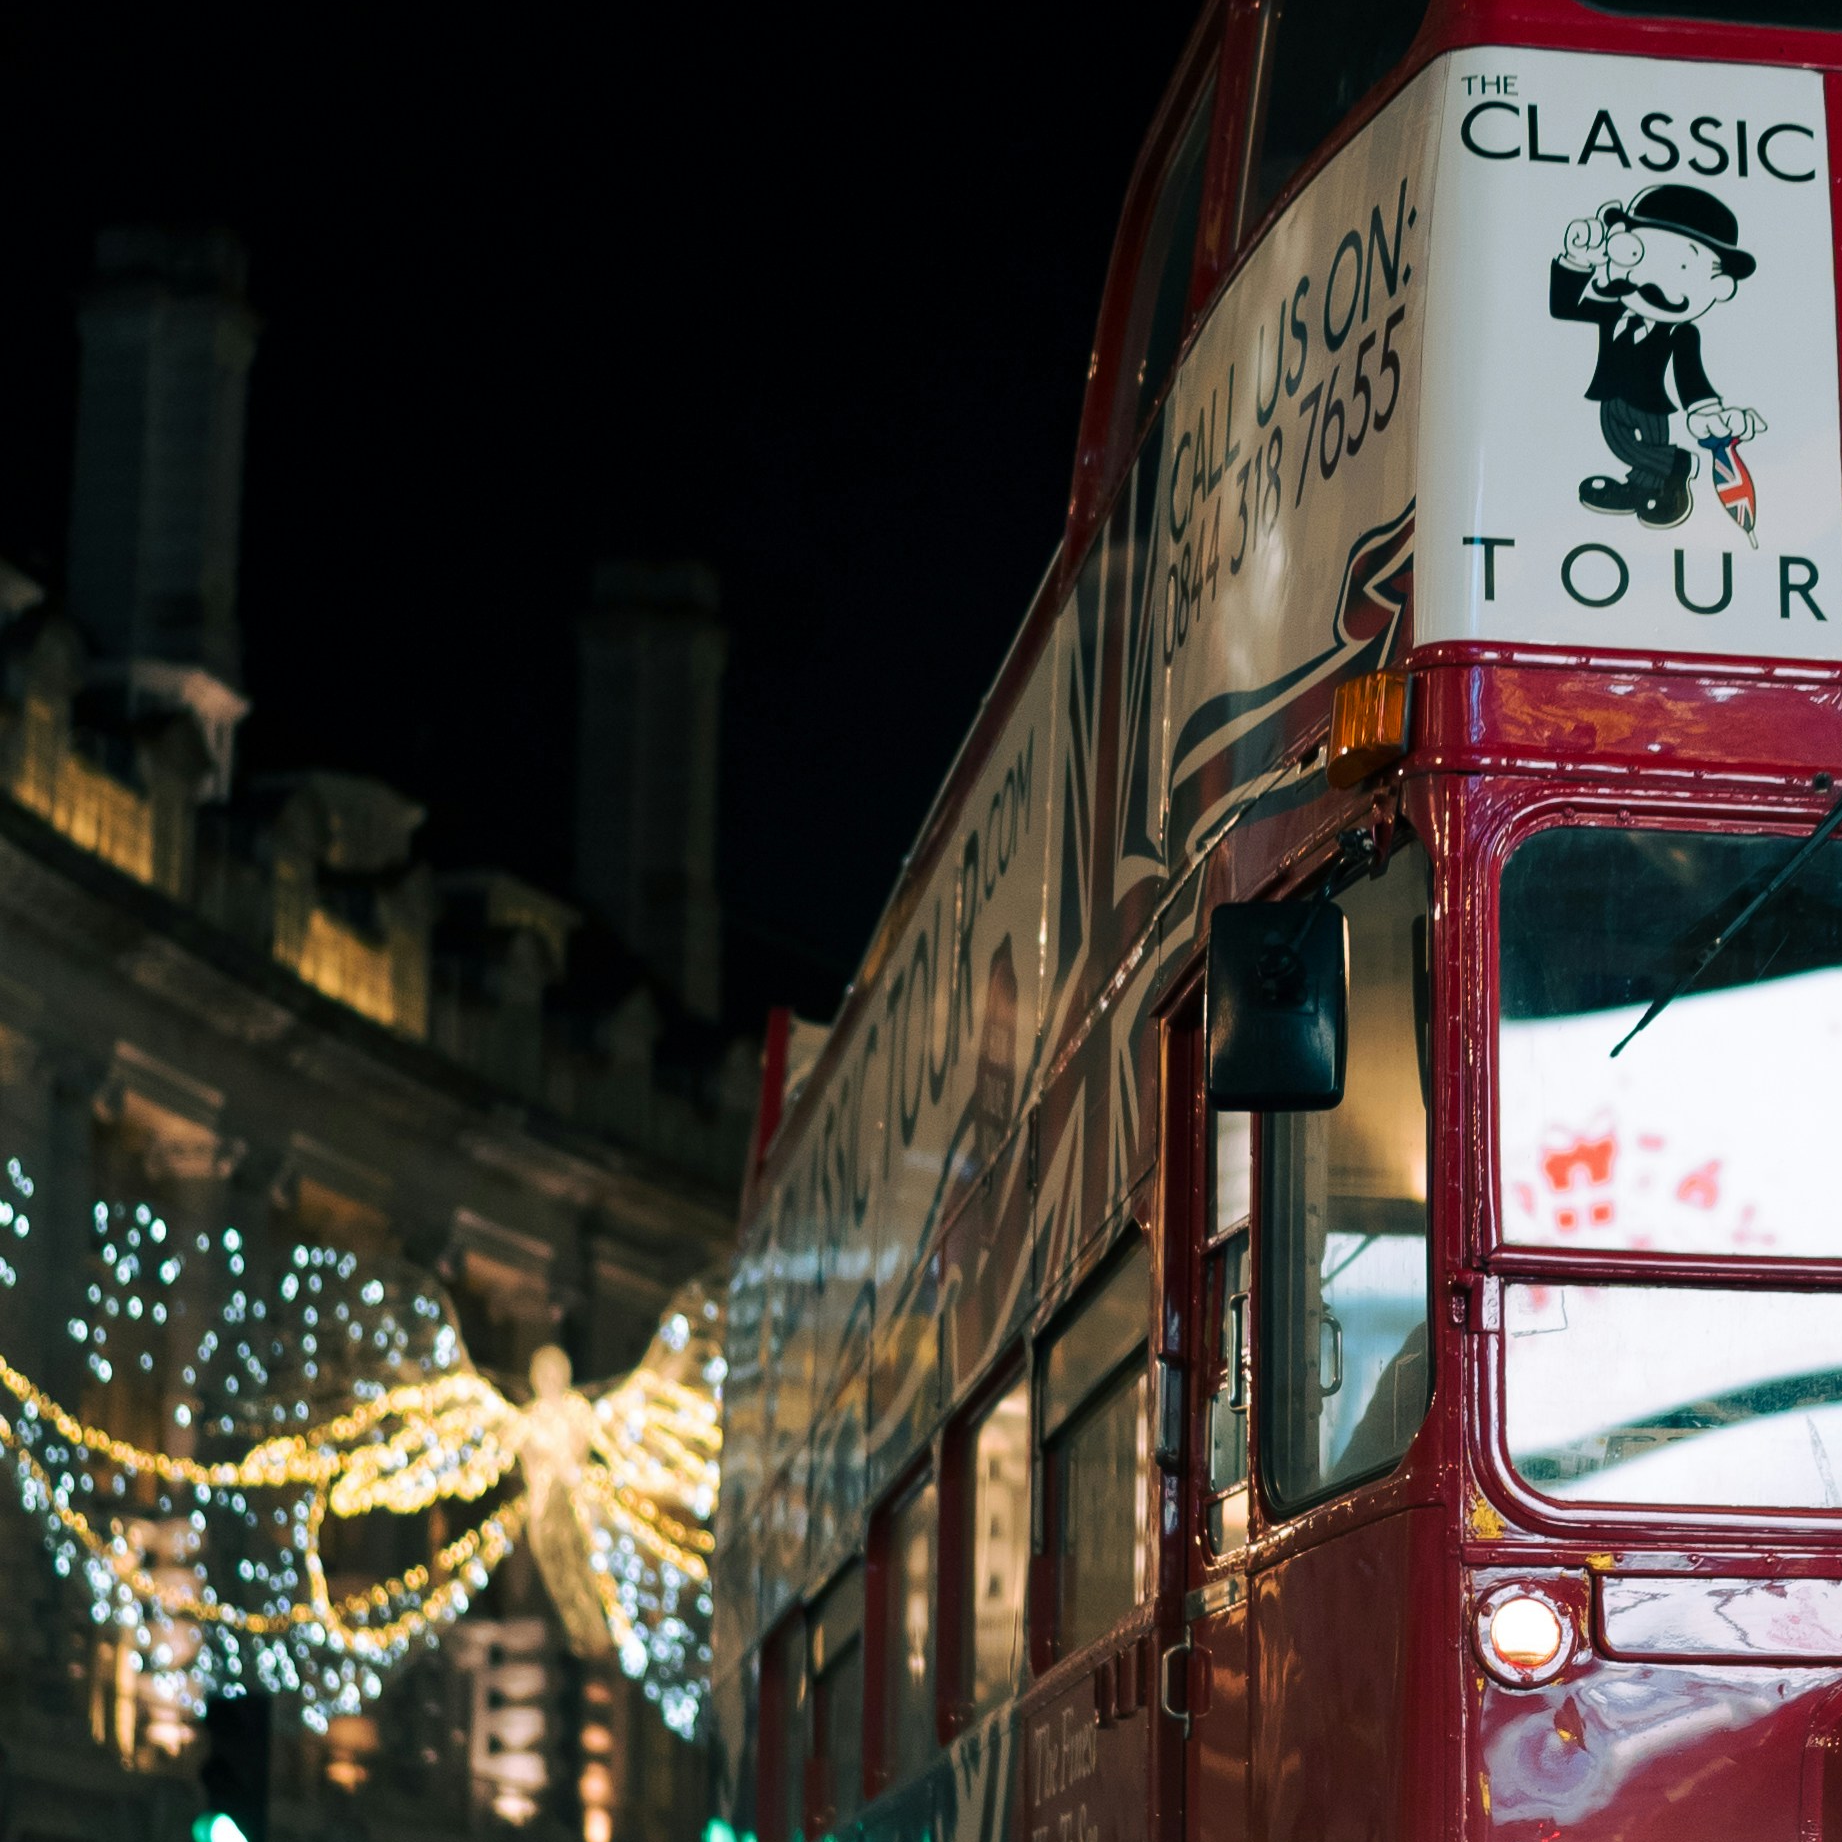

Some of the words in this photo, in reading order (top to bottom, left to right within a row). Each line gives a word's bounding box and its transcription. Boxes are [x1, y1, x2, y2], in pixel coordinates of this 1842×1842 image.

[1461, 75, 1518, 96] THE
[1460, 100, 1817, 183] CLASSIC
[1169, 362, 1241, 544] CALL
[1255, 275, 1310, 428] US
[1323, 177, 1418, 353] ON:
[1162, 496, 1222, 667] 0844
[1230, 425, 1283, 576] 318
[1295, 305, 1406, 509] 7655
[1462, 536, 1828, 621] TOUR
